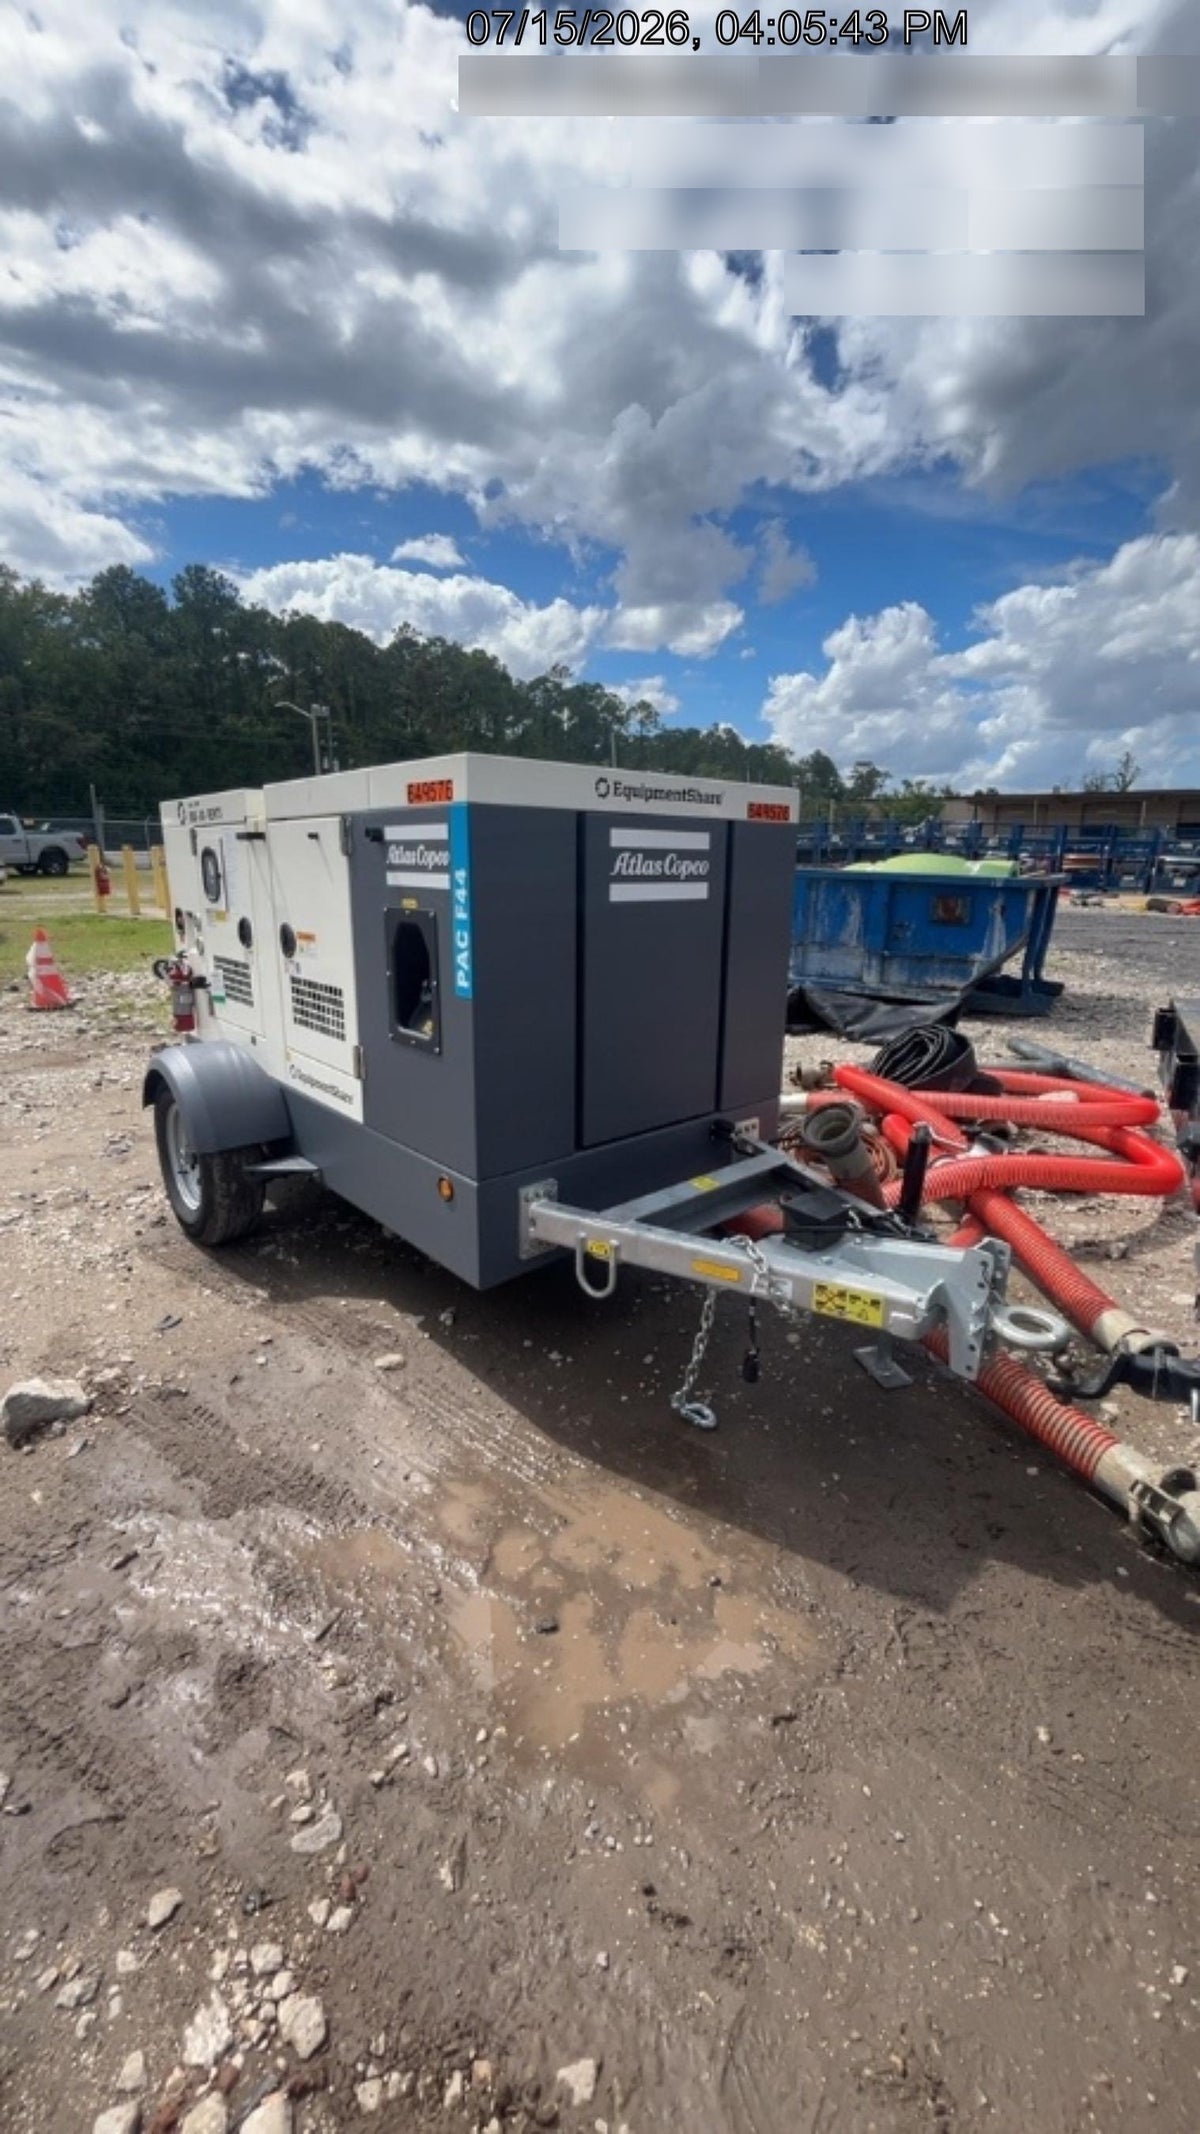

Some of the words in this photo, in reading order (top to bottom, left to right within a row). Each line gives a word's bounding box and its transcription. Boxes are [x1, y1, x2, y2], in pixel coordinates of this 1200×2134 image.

[613, 780, 724, 805] EquipmentShare
[609, 851, 663, 876] Atlas
[663, 852, 710, 881] Copco
[454, 868, 469, 919] F44
[456, 929, 470, 989] PAC
